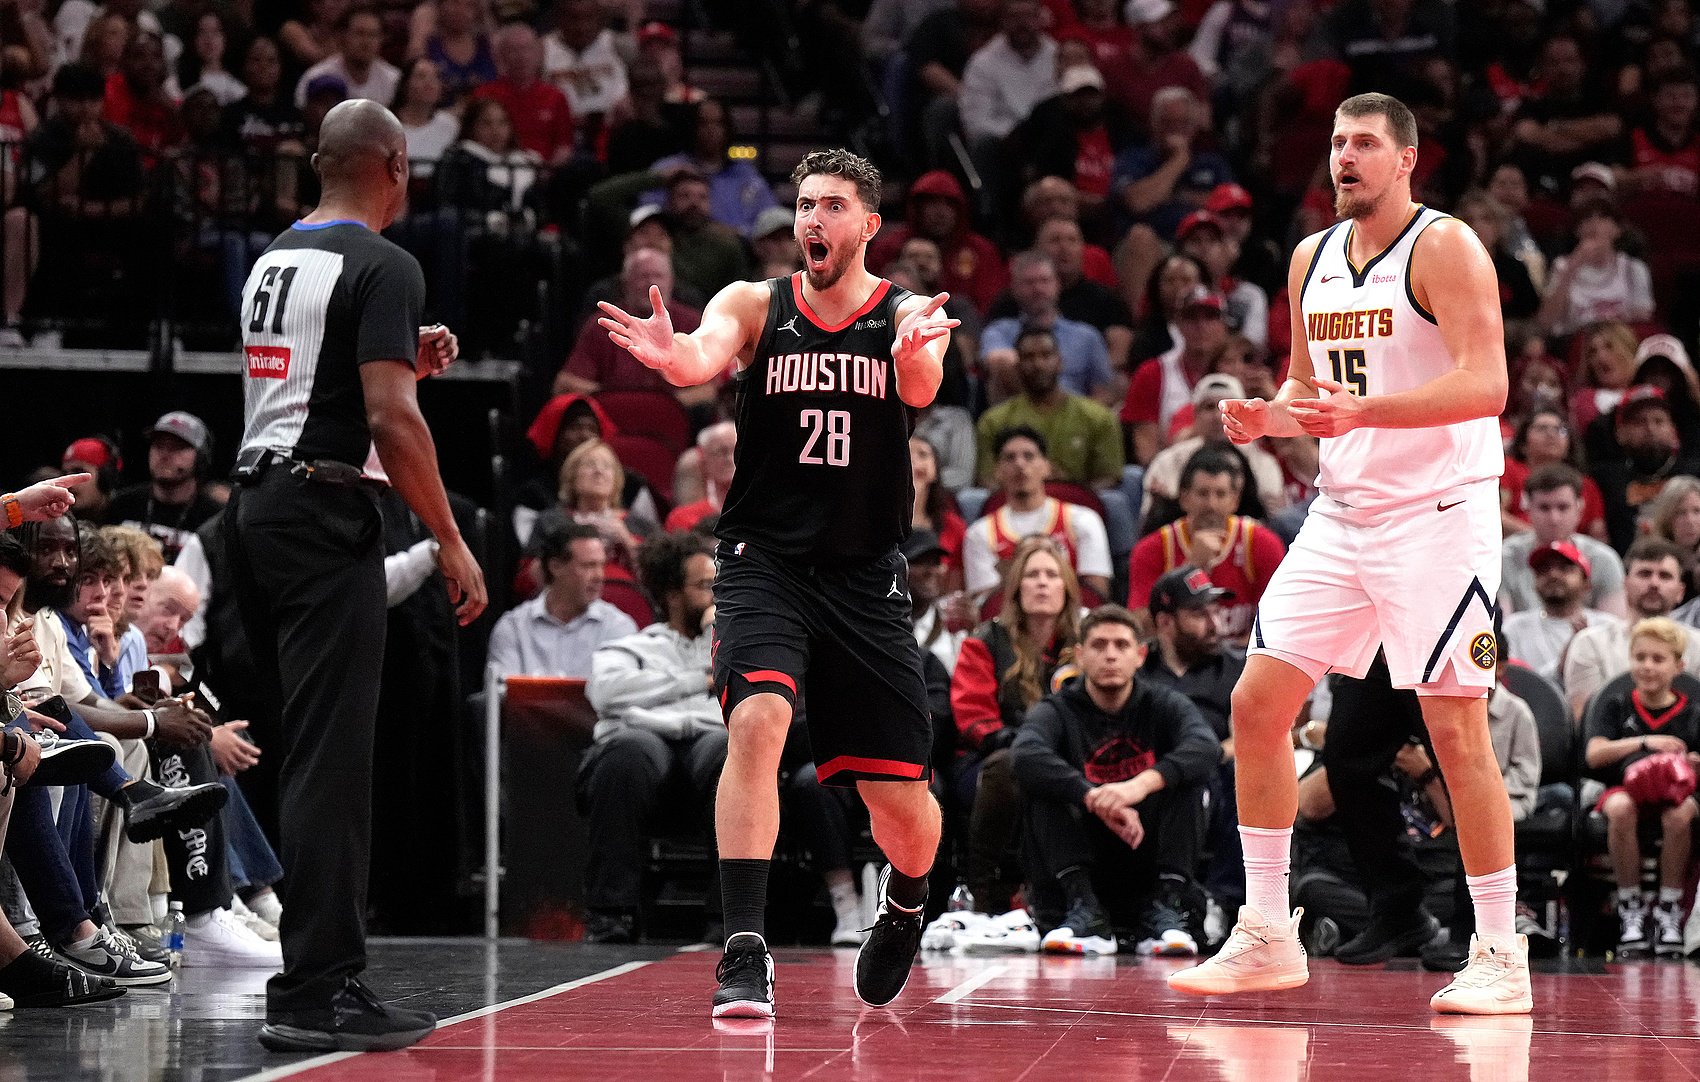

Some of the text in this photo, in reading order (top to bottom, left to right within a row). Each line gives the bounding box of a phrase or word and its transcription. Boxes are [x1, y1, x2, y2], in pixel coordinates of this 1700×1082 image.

[249, 266, 298, 334] 61
[1372, 274, 1397, 284] ibotta
[1308, 308, 1393, 342] NUGGETS
[765, 352, 888, 400] HOUSTON
[1327, 347, 1367, 397] 15
[799, 409, 851, 467] 28
